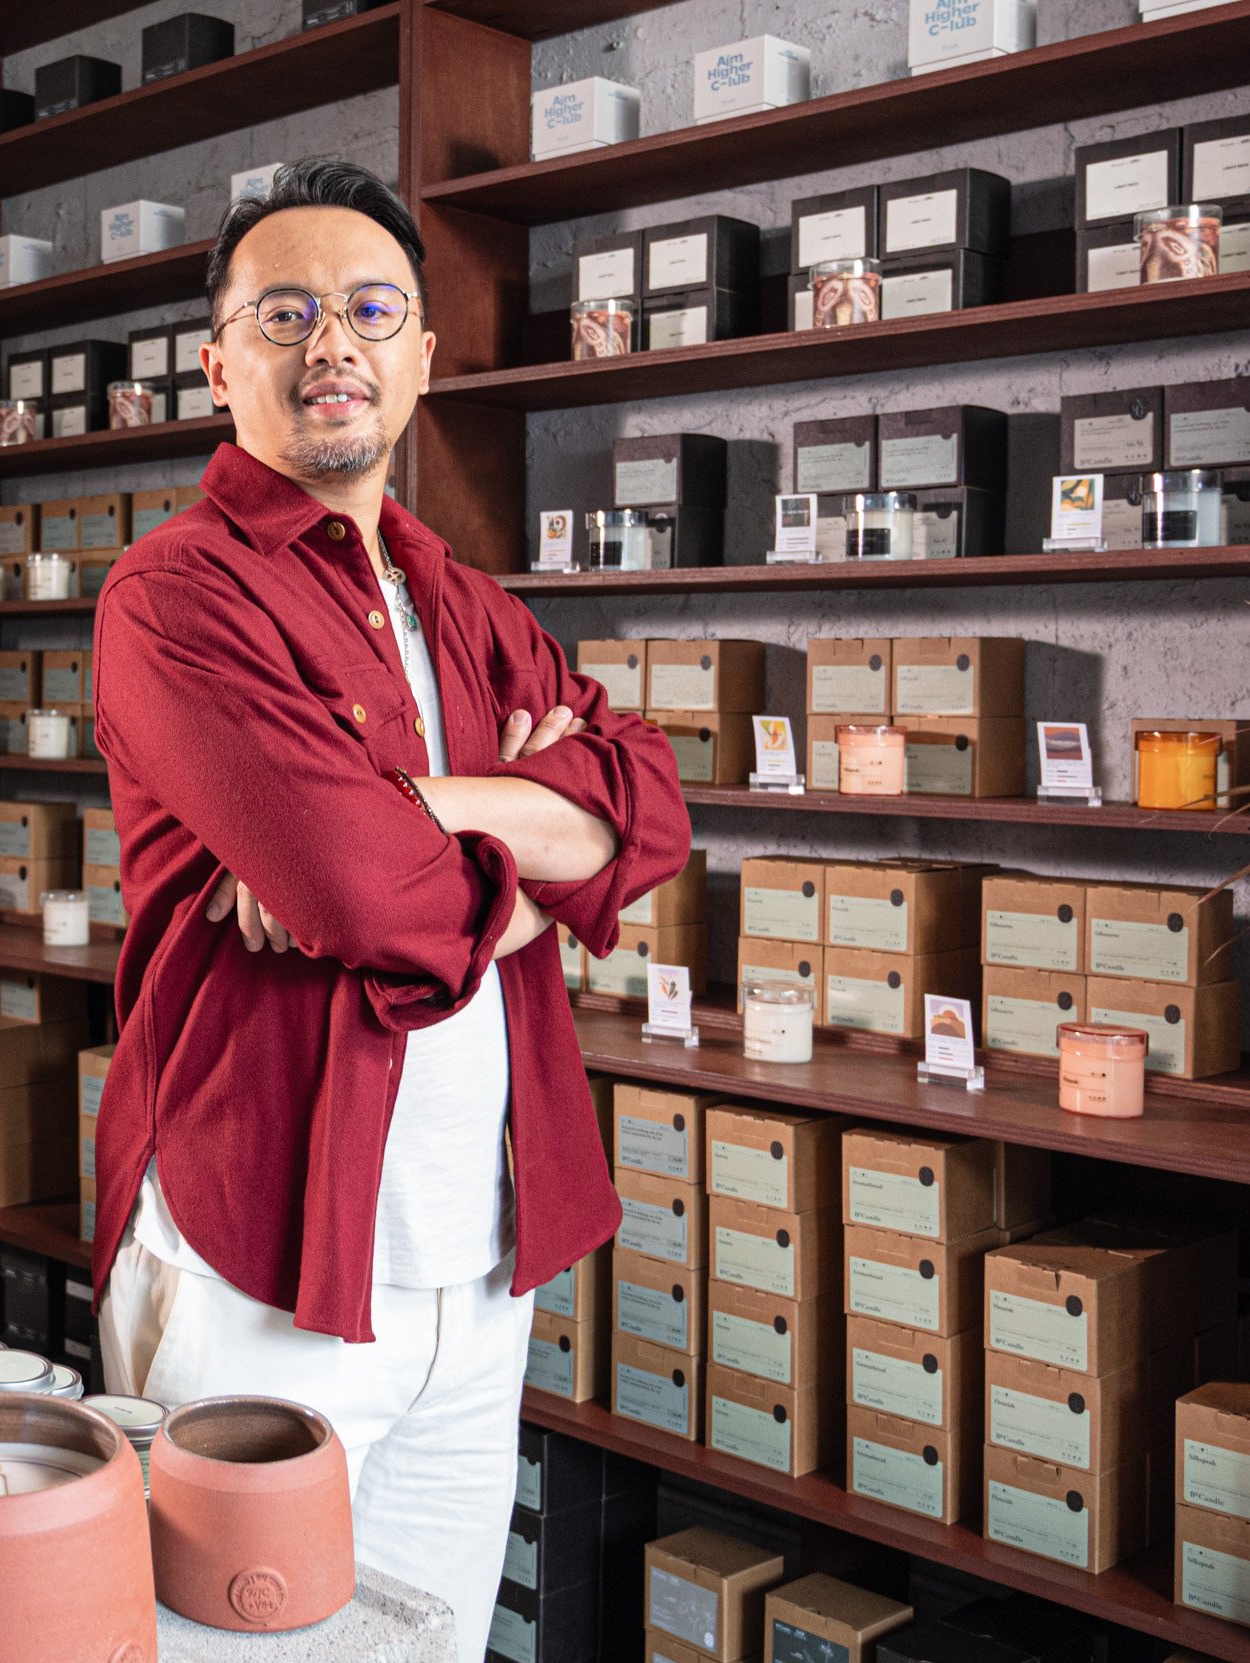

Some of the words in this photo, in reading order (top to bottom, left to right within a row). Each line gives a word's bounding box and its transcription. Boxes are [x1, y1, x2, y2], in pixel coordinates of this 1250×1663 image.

[925, 2, 980, 24] Higher
[717, 54, 743, 67] Aim
[708, 61, 753, 80] Higher
[553, 94, 576, 105] Aim
[545, 101, 585, 118] Higher
[994, 1337, 1025, 1351] BeCandle
[995, 1432, 1026, 1448] BeCandle
[1190, 1490, 1224, 1506] BeCandle
[1188, 1592, 1224, 1612] BeCandle
